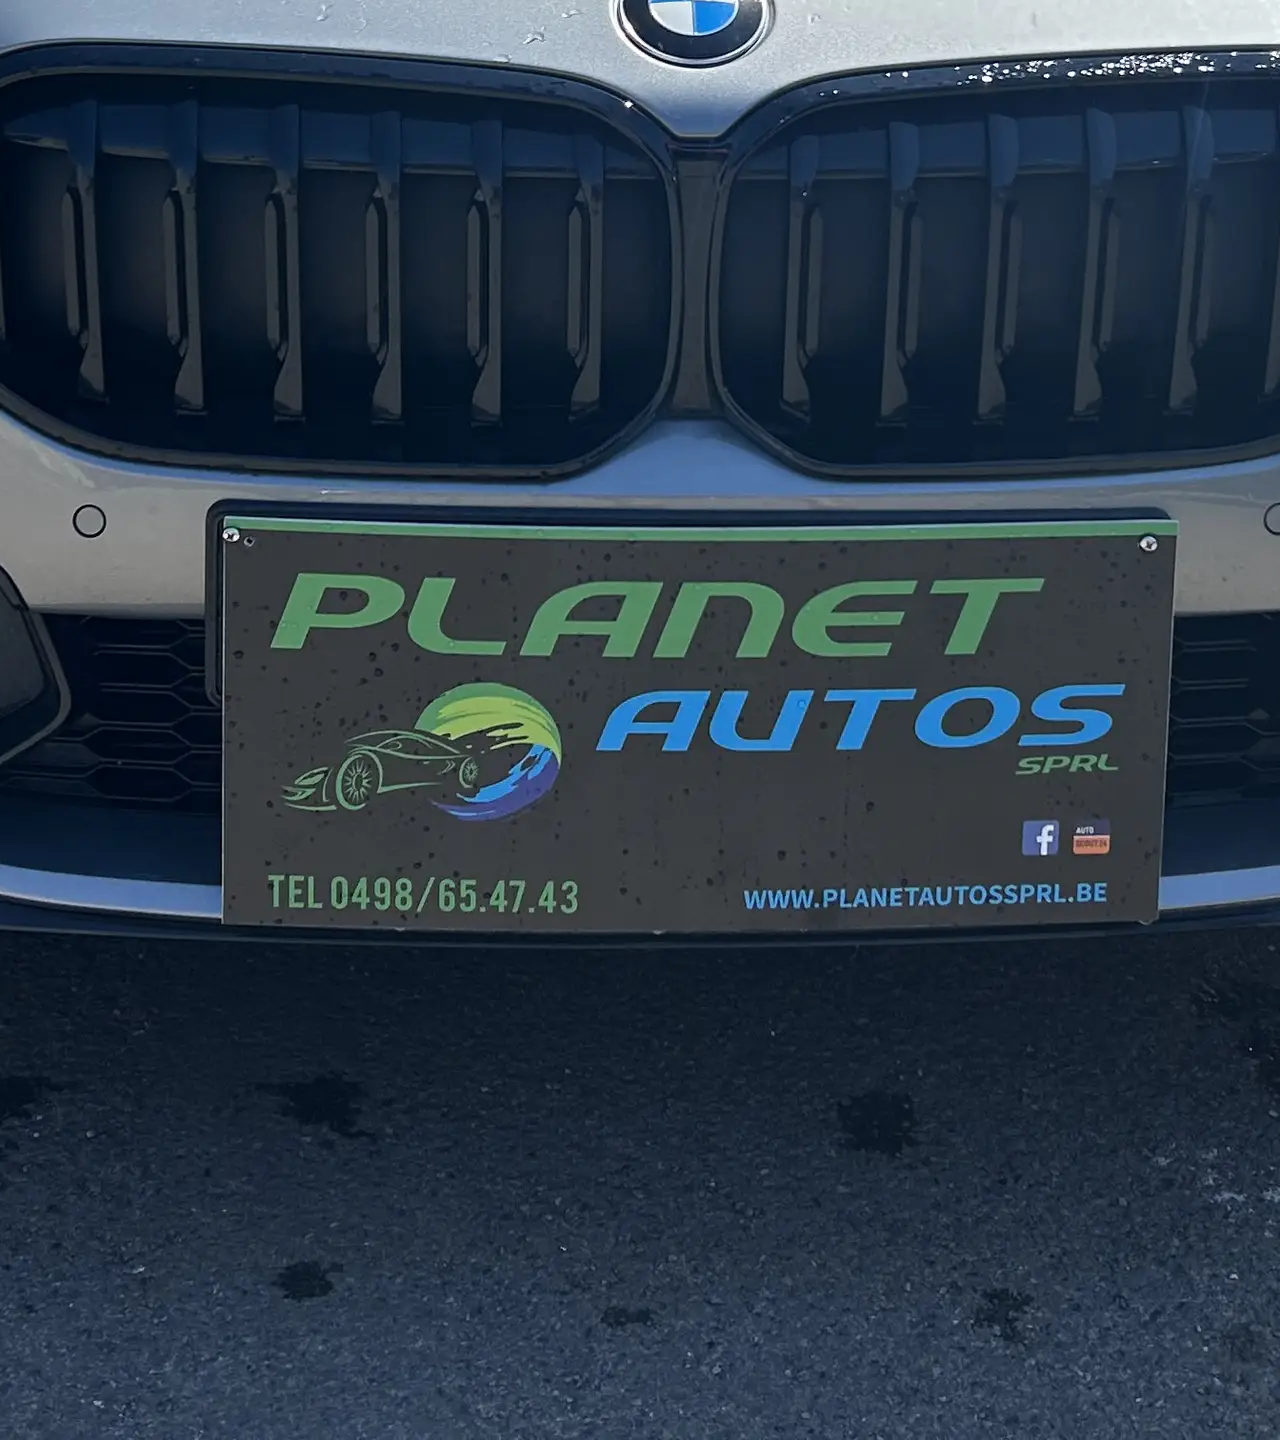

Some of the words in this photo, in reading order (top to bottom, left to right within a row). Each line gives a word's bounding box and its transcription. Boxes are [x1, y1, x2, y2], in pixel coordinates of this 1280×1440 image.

[270, 571, 1045, 660] PLANET
[595, 683, 1126, 751] AUTOS
[1015, 753, 1119, 775] SPRL
[1075, 826, 1095, 834] AUTO
[267, 874, 323, 910] TEL
[330, 875, 580, 914] 0498/65.47.43
[743, 882, 1108, 910] WWW.PLANETAUTOSSPRL.BE
